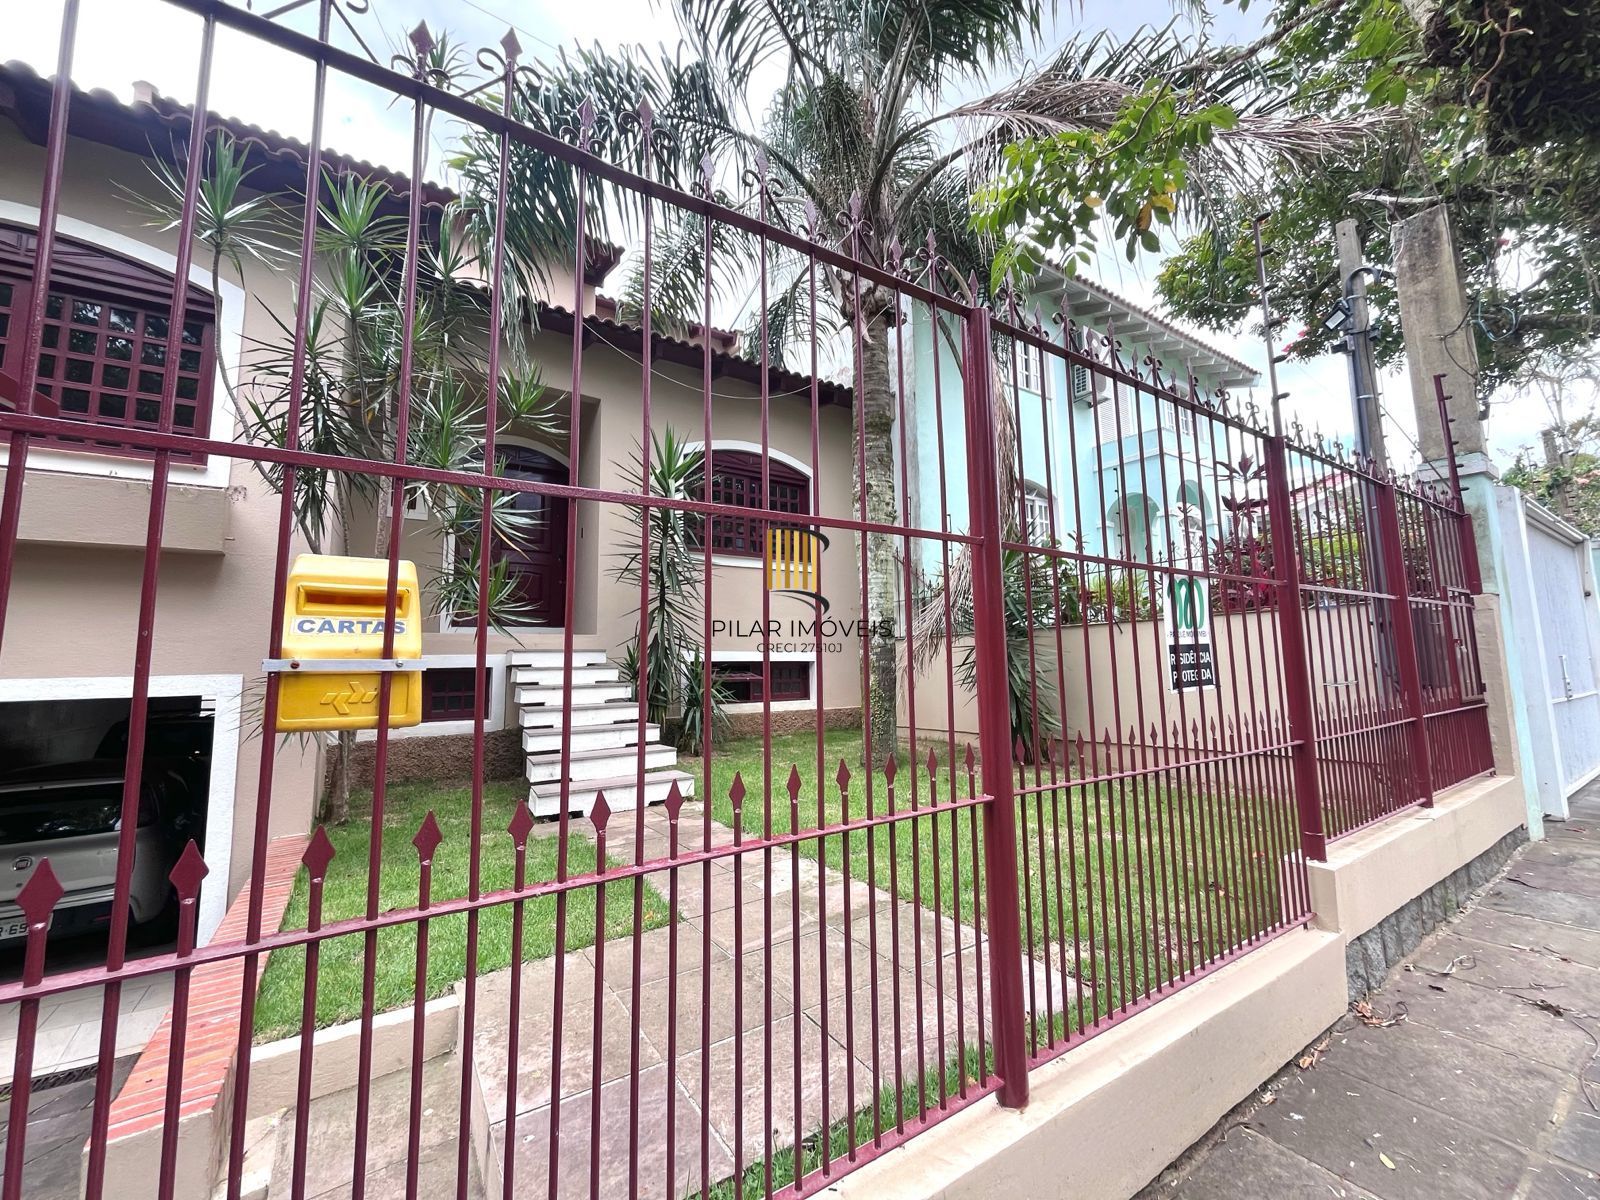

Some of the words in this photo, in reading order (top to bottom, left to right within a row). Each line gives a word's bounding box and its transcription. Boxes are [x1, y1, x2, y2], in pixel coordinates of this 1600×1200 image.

[297, 619, 406, 634] CARTAS
[1170, 650, 1211, 666] RSIDÊCIA
[1173, 668, 1212, 683] POTEGDA
